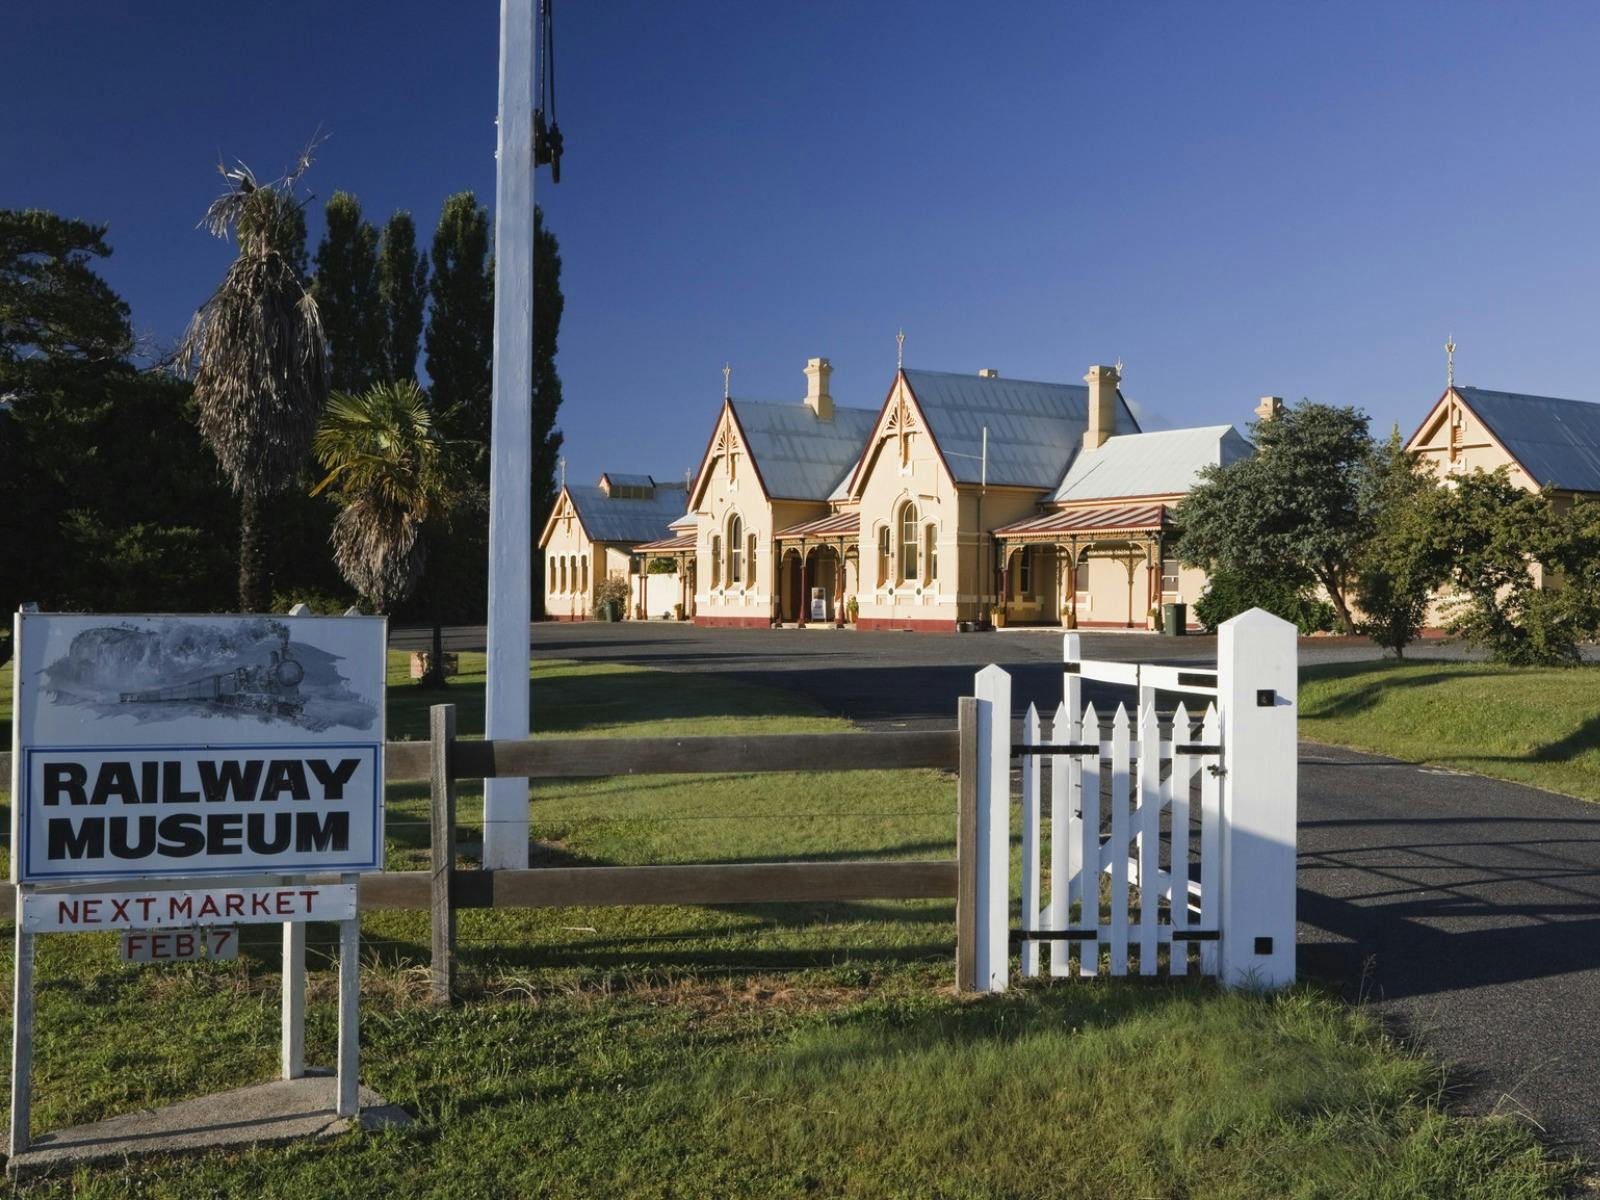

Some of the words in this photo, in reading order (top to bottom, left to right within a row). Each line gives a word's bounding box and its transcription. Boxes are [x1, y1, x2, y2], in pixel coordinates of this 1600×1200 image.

[43, 758, 361, 806] RAILWAY
[47, 812, 350, 860] MUSEUM
[168, 890, 320, 919] MARKET
[127, 933, 195, 960] FEB
[212, 931, 231, 954] 7
